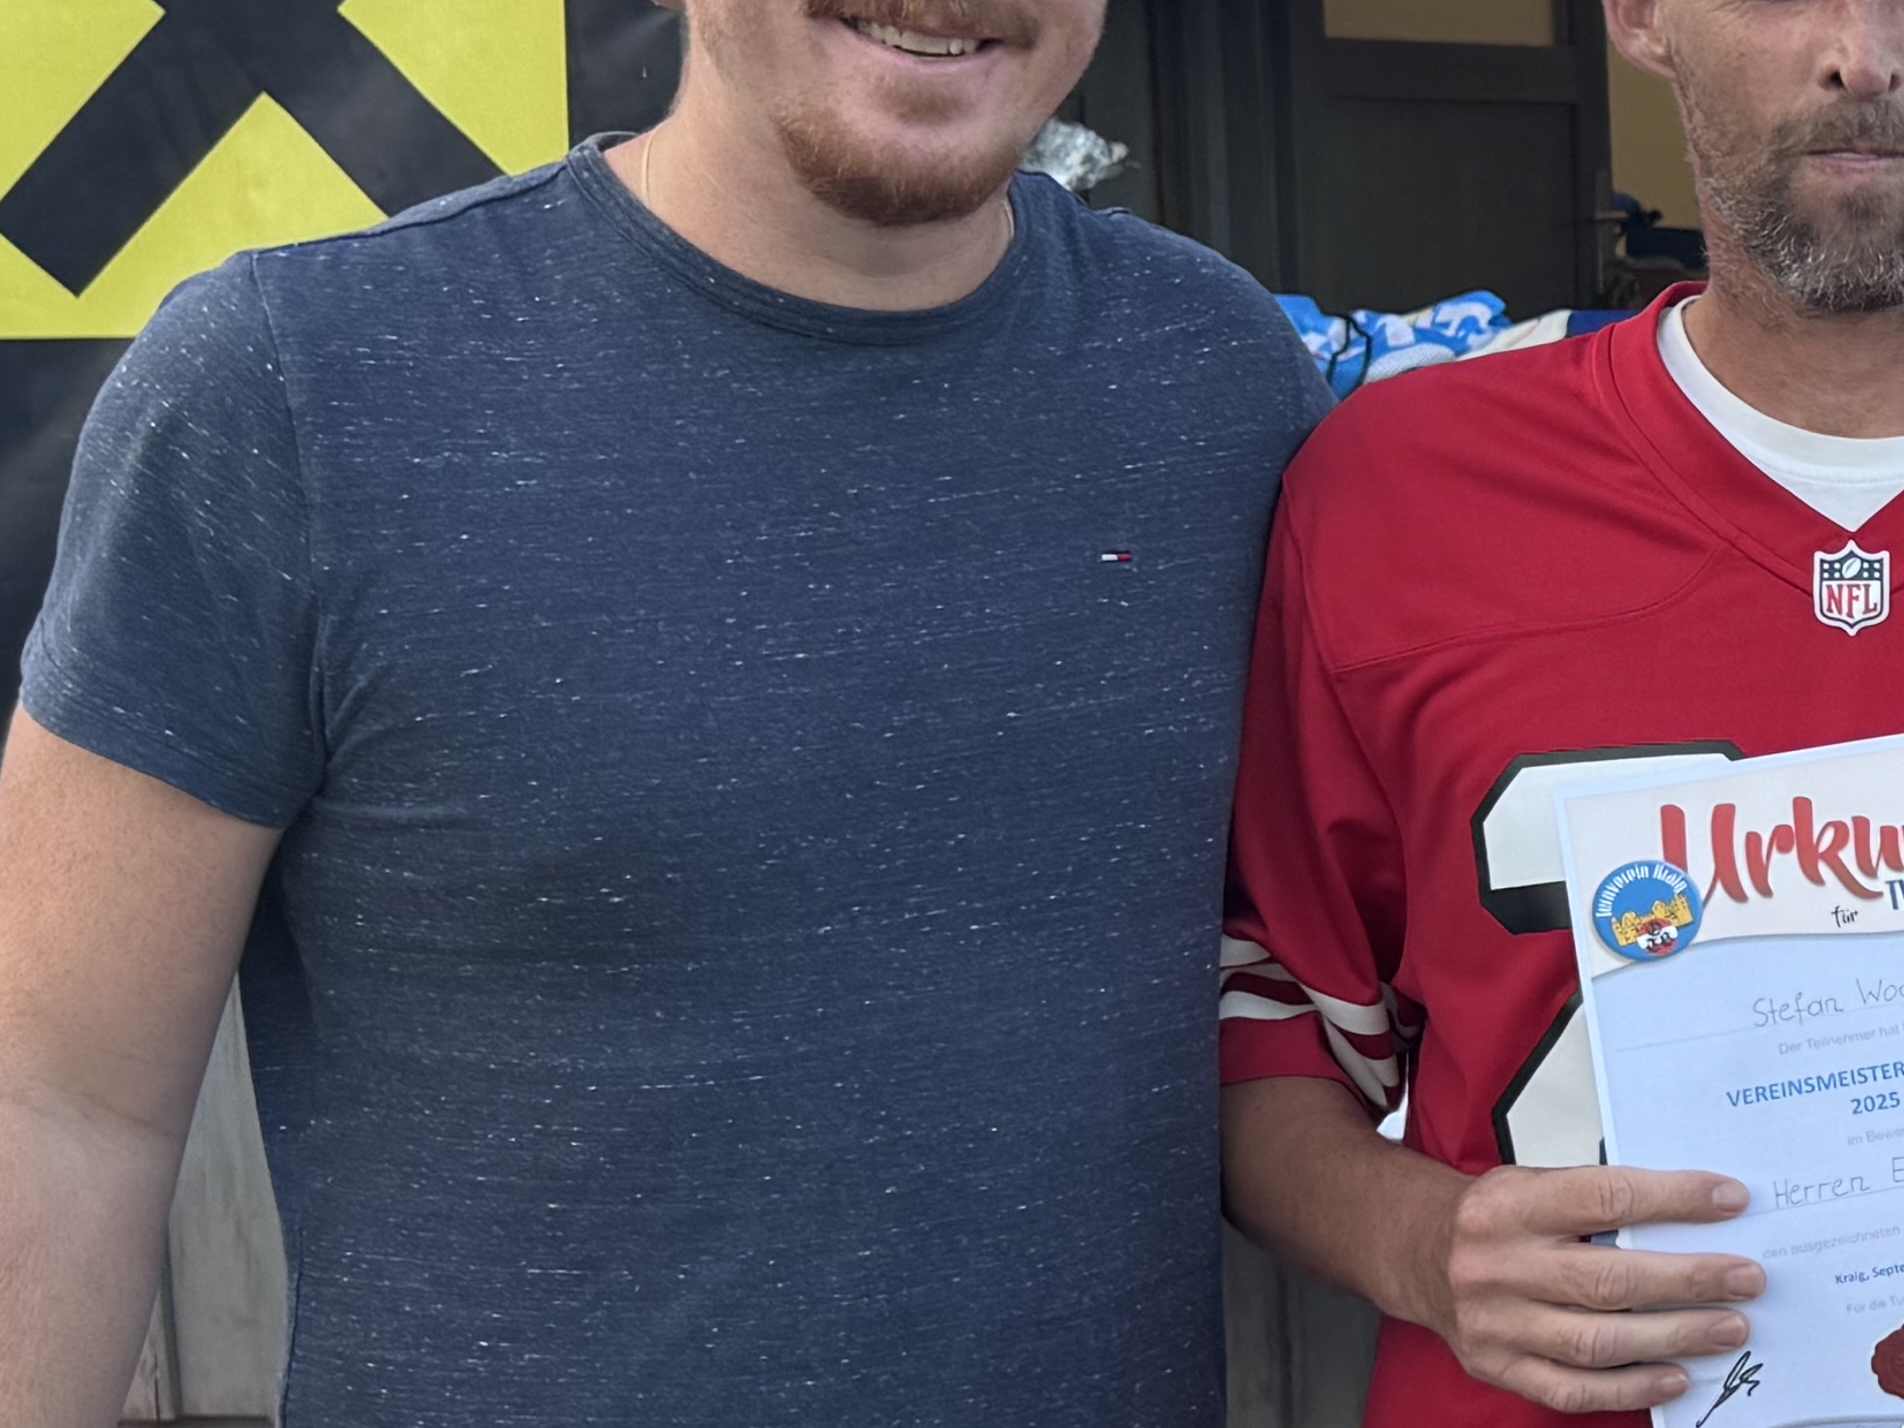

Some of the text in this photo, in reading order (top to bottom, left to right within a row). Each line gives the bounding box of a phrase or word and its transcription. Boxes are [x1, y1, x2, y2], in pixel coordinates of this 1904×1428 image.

[1825, 583, 1878, 620] NFL
[1831, 904, 1859, 928] für
[1752, 991, 1844, 1027] Stefan
[1806, 1030, 1875, 1051] Teilnehmer
[1850, 1092, 1902, 1116] 2025
[1772, 1174, 1871, 1210] Herren
